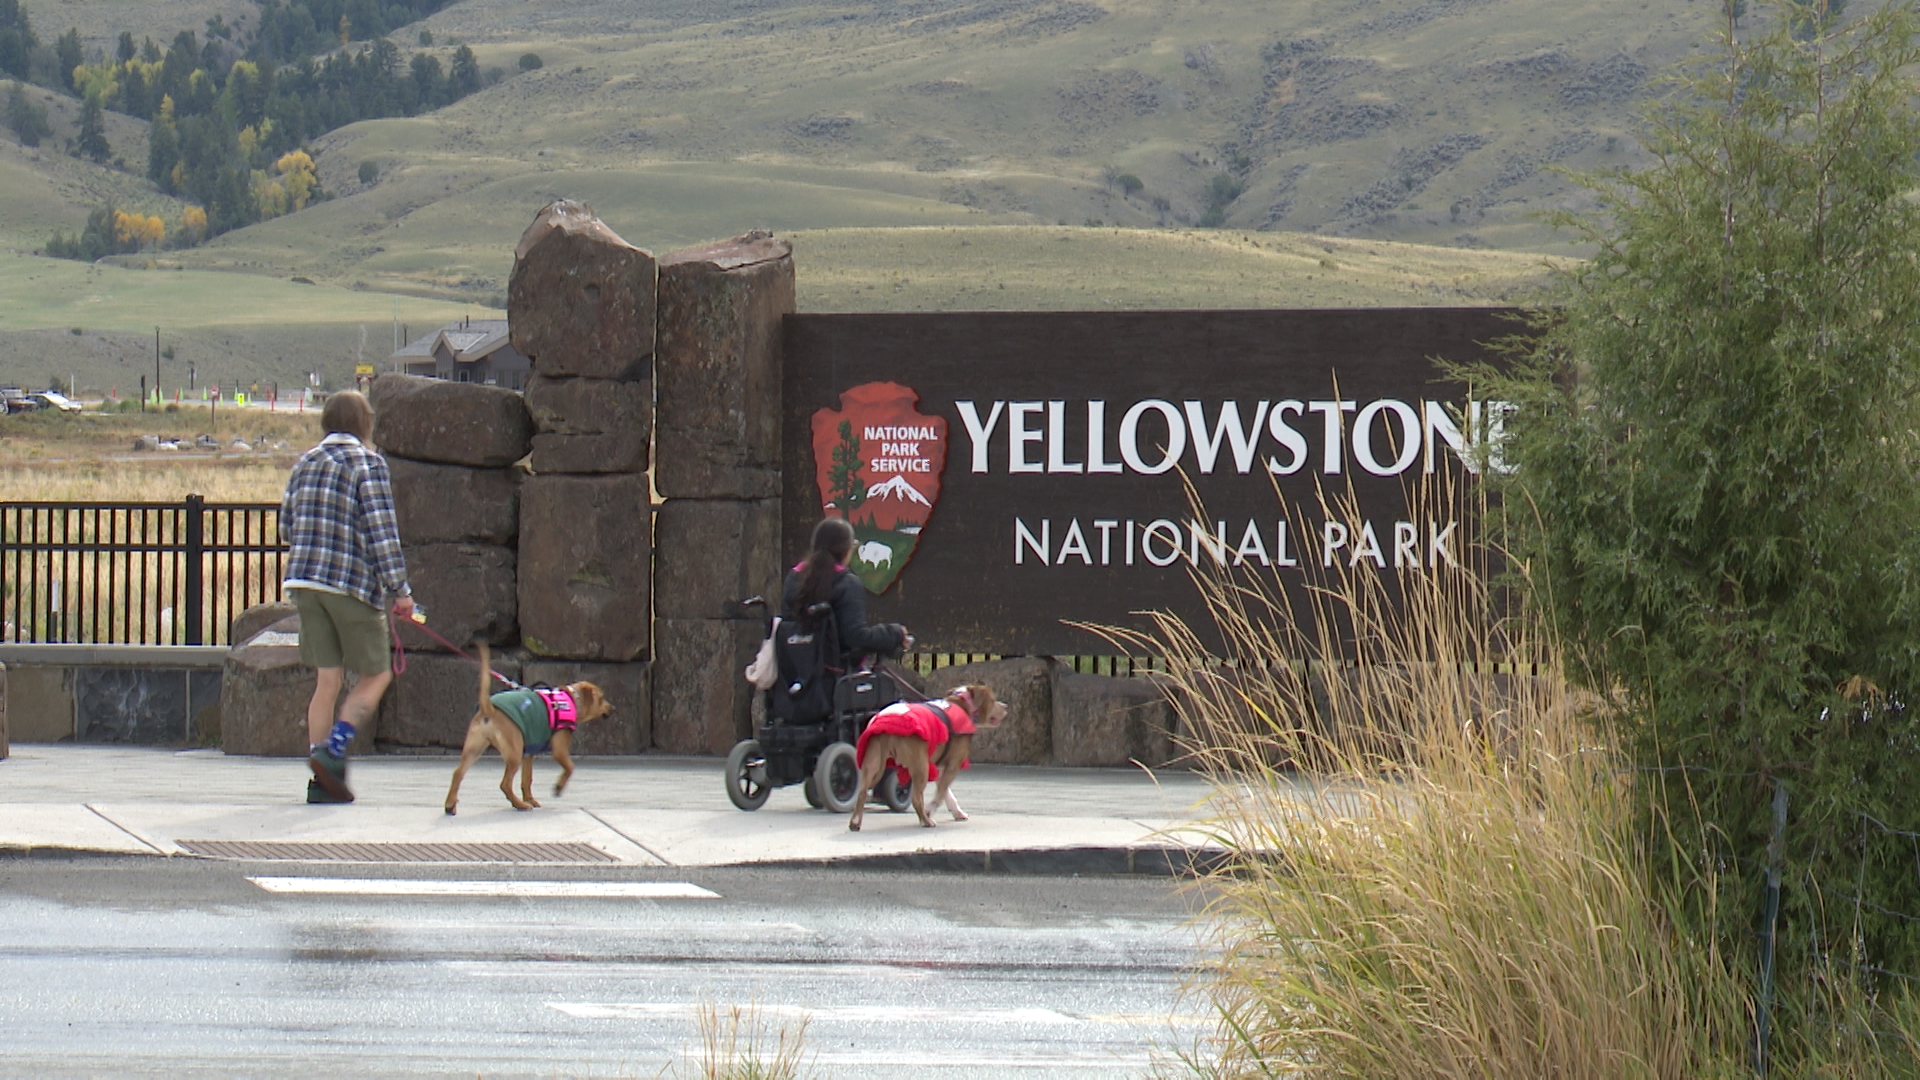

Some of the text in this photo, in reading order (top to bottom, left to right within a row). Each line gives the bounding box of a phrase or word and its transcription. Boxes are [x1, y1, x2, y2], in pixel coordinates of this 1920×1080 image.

[863, 426, 938, 441] NATIONAL
[955, 399, 1520, 475] YELLOWSTONE
[881, 442, 920, 457] PARK
[870, 458, 931, 473] SERVICE
[1014, 517, 1459, 568] NATIONAL PARK
